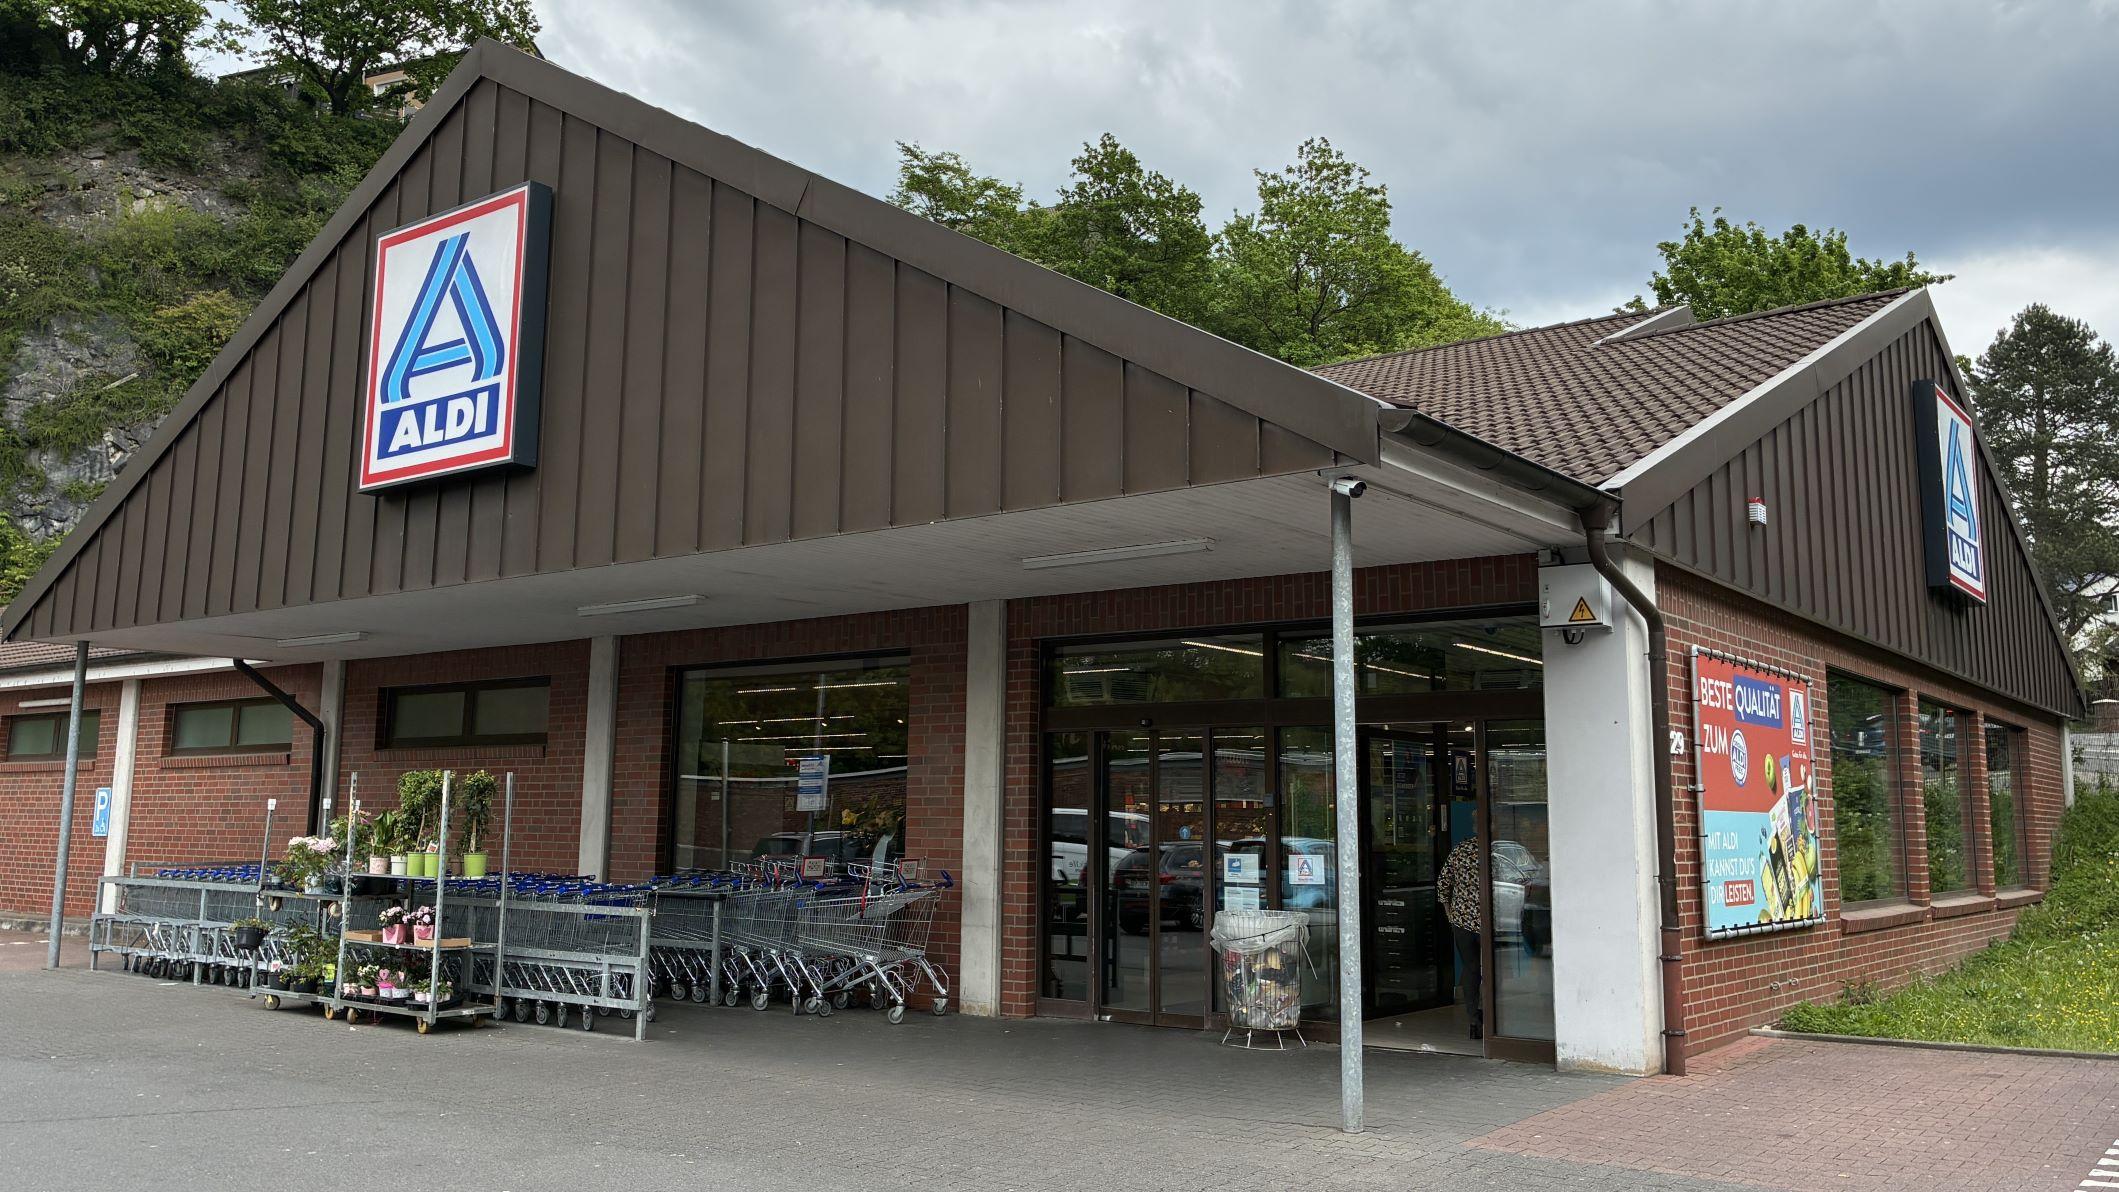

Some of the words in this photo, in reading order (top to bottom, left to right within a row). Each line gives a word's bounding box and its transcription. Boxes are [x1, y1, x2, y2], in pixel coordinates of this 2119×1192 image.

[388, 391, 490, 453] ALDI
[1951, 534, 1977, 577] ALDI
[1700, 676, 1733, 711] BESTE
[1735, 684, 1780, 720] QUALITÄT
[1670, 731, 1685, 755] 29
[1703, 723, 1729, 755] ZUM
[1732, 745, 1747, 769] ALDI
[96, 791, 108, 821] P
[1708, 832, 1721, 850] MIT
[1722, 832, 1739, 850] ALDI
[1709, 857, 1738, 877] KANNST
[1710, 885, 1724, 905] DIR
[1725, 883, 1754, 903] LEISTEN.
